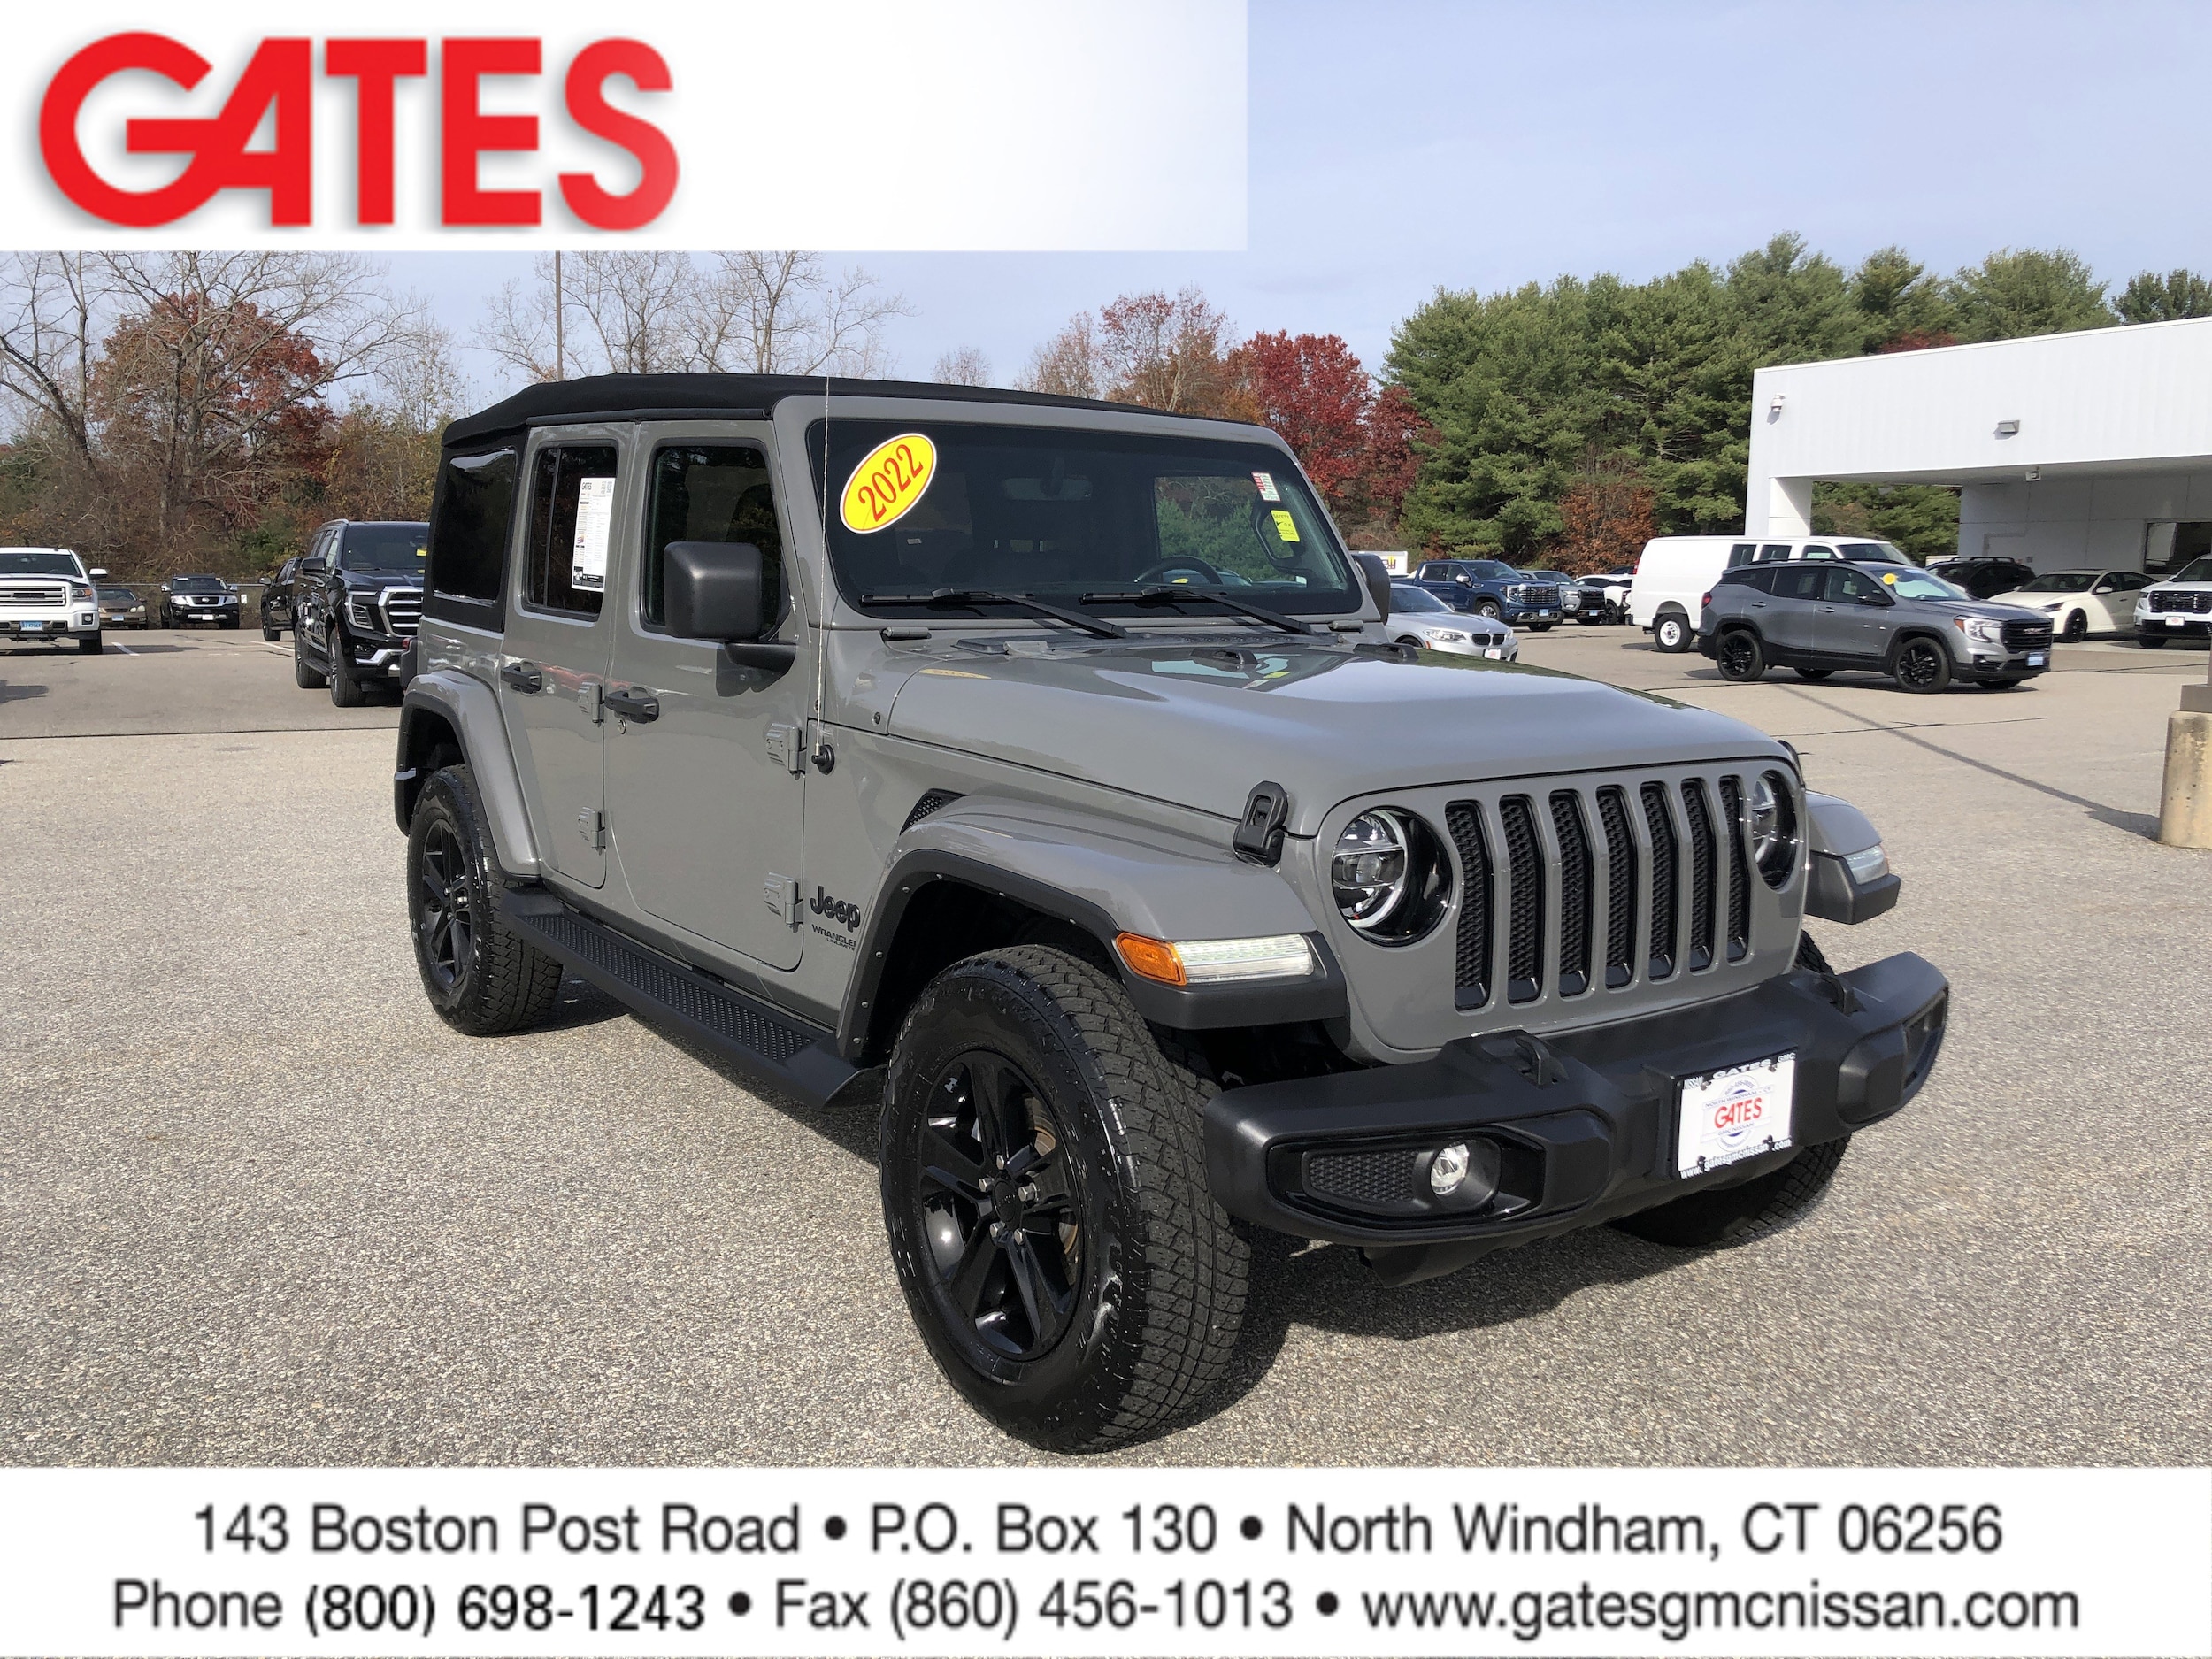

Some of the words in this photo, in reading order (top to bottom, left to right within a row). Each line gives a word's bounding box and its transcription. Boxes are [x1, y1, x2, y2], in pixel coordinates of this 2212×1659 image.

[858, 444, 924, 522] 2022
[810, 885, 861, 933] Jeep
[826, 937, 855, 951] UNLIMITE
[1713, 1058, 1771, 1079] GATES
[1777, 1053, 1795, 1063] GMC
[1714, 1096, 1763, 1129] GATES
